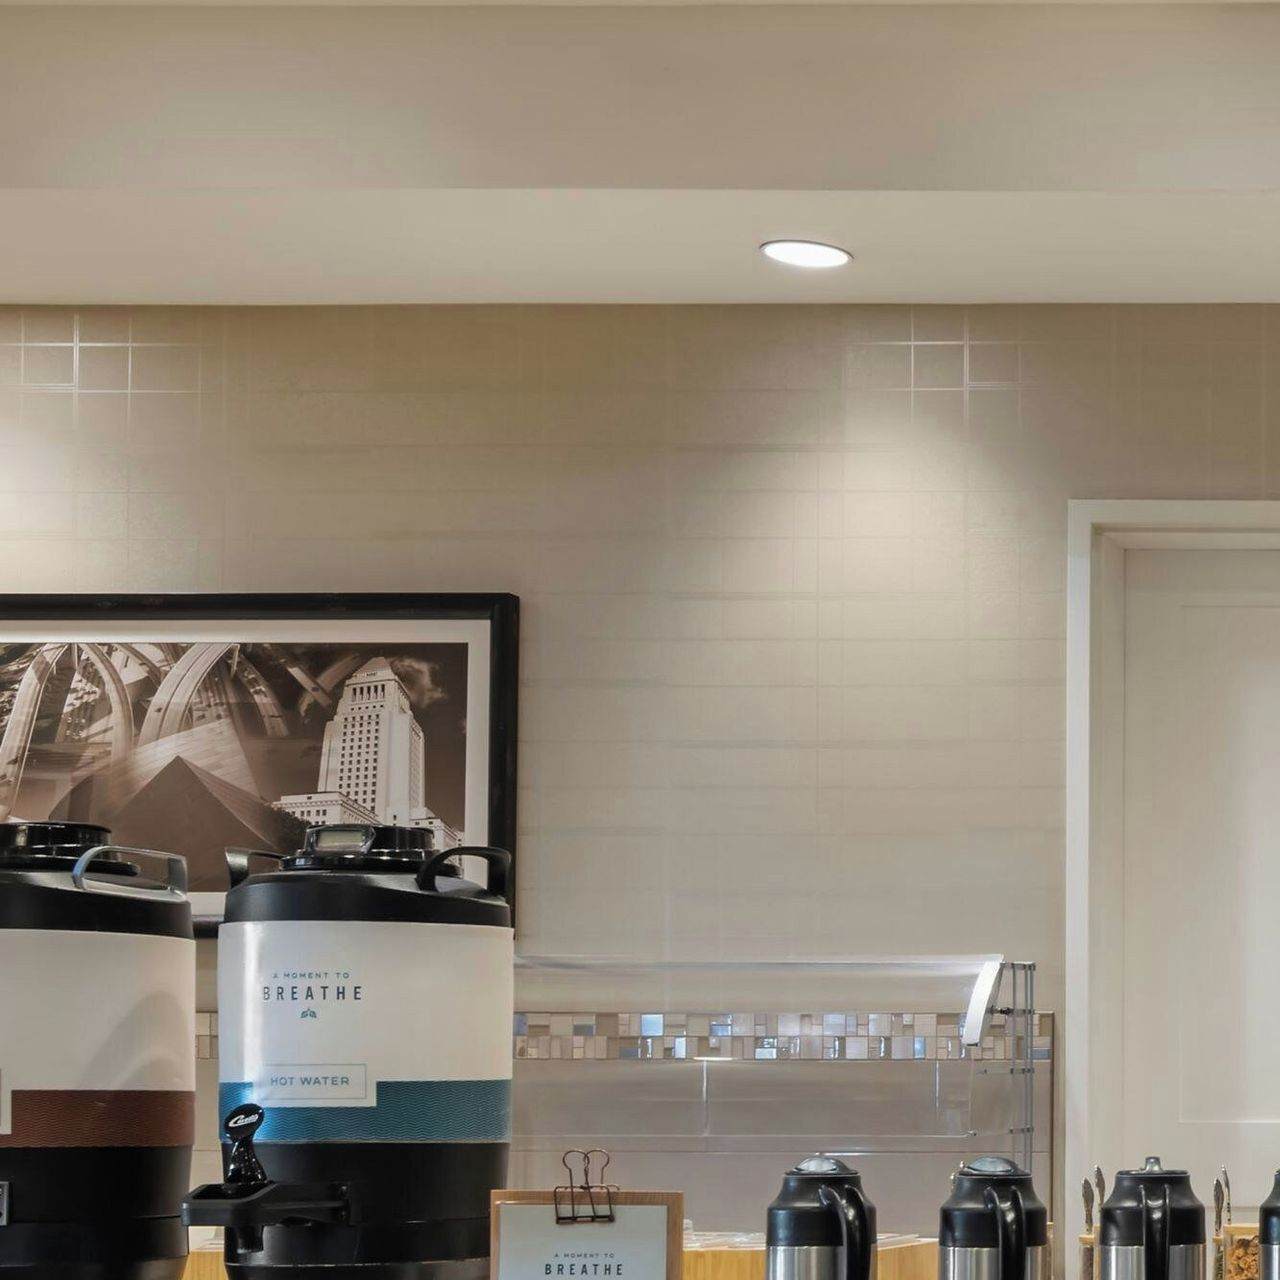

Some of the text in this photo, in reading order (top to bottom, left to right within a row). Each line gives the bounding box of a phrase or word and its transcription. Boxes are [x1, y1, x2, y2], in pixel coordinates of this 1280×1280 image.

[263, 986, 362, 1000] BREATHE
[270, 1076, 350, 1086] HOT WATER
[544, 1263, 623, 1276] BREATHE
